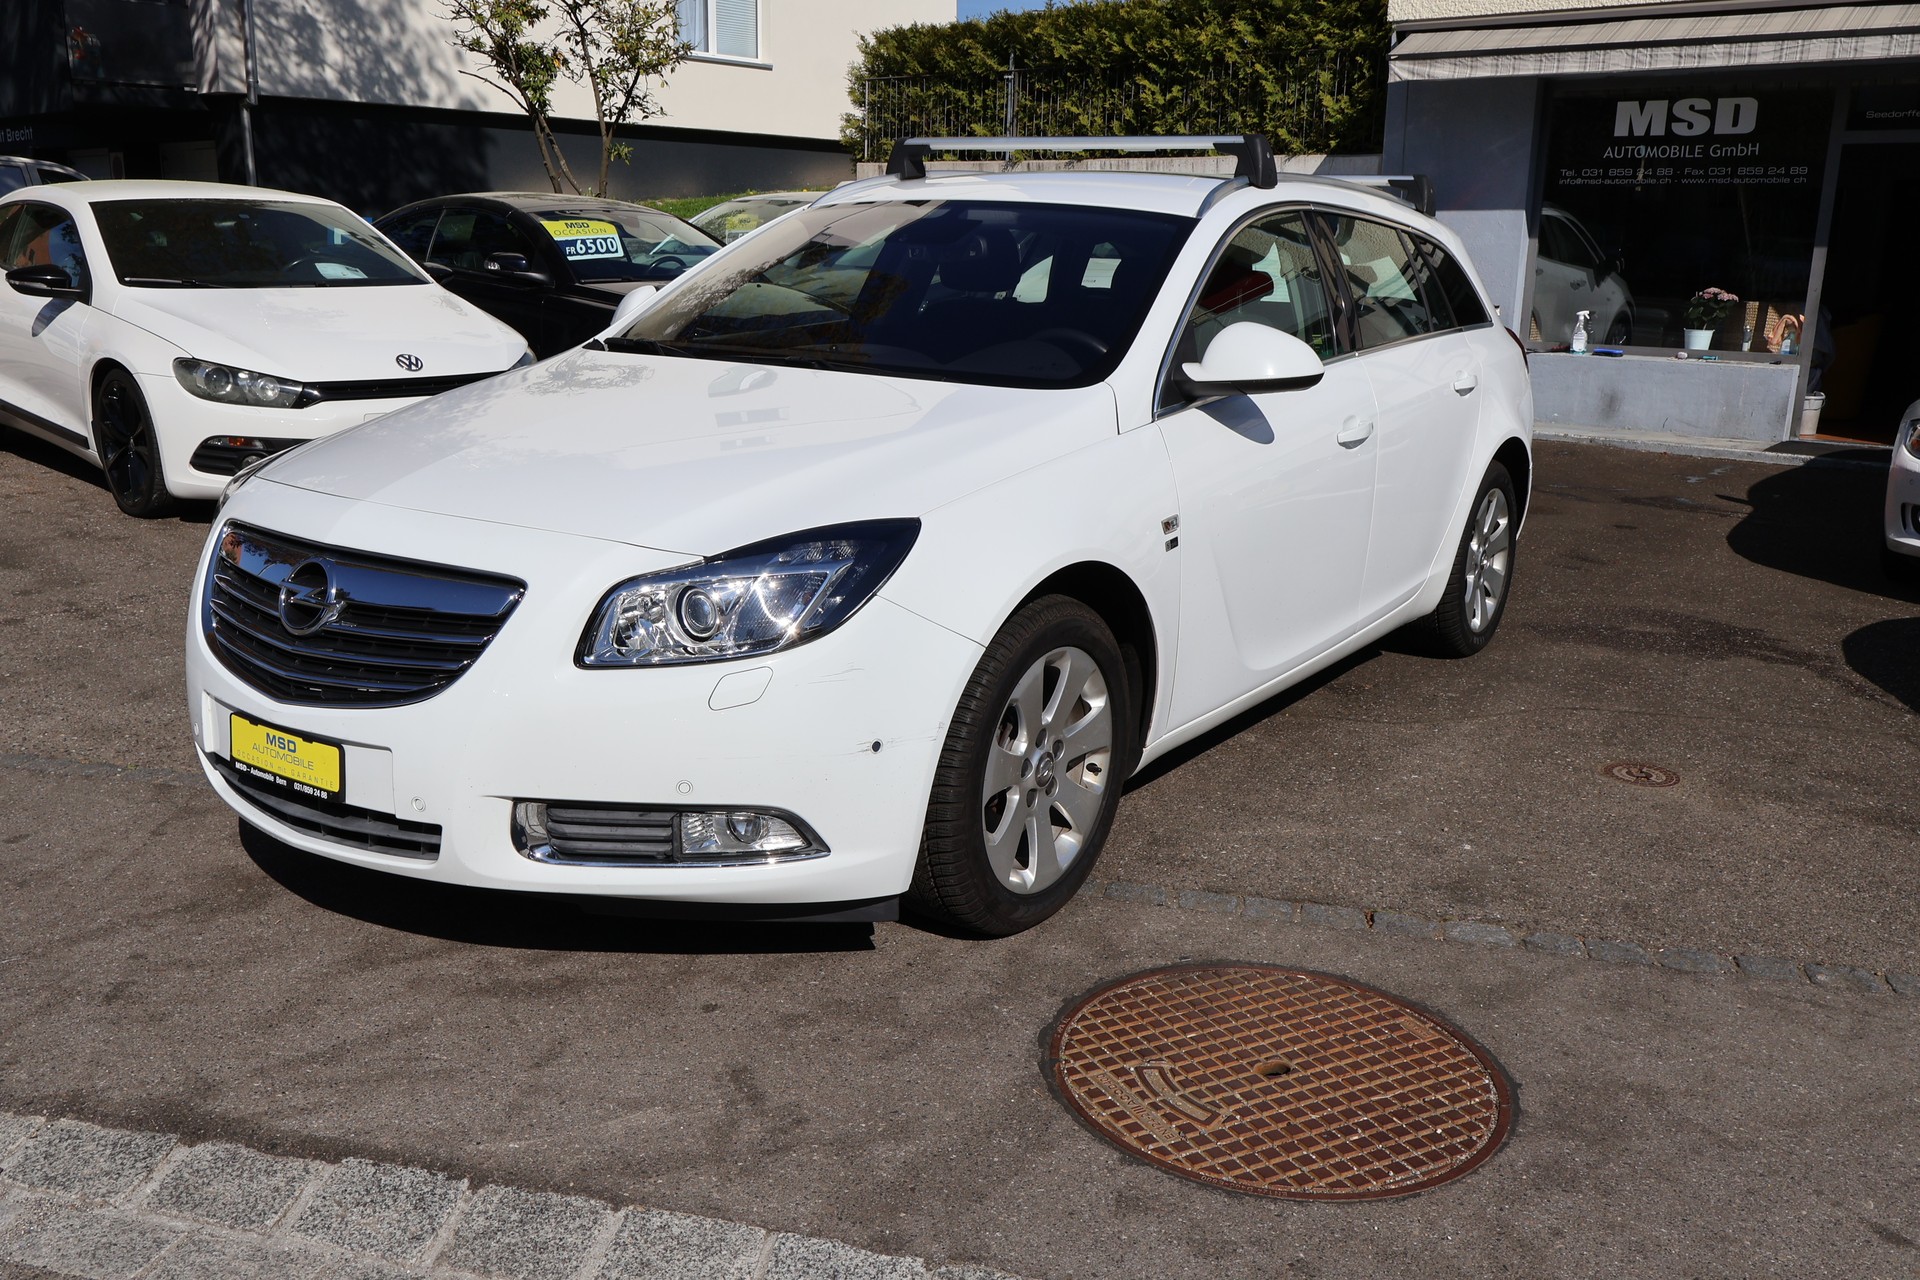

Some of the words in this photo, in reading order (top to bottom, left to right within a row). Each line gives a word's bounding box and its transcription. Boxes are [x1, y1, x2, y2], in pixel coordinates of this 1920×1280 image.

[1613, 97, 1759, 137] MSD
[6, 126, 33, 142] Brecht
[1603, 145, 1704, 159] AUTOMOBILE
[1709, 143, 1760, 158] GmbH
[1560, 169, 1578, 177] Tel.
[1581, 168, 1603, 177] 031
[1608, 168, 1633, 176] 859
[1636, 168, 1653, 176] 24
[1656, 167, 1674, 176] 88
[1684, 167, 1705, 176] Fax
[1708, 167, 1732, 176] 031
[1737, 166, 1764, 175] 859
[1767, 166, 1786, 175] 24
[1789, 166, 1808, 175] 89
[553, 228, 607, 236] OCCASION
[576, 238, 617, 254] 6500
[266, 732, 297, 753] MSD
[252, 742, 314, 771] AUTOMOBILE
[237, 749, 274, 768] OCCASION
[290, 769, 334, 789] GARANTIE
[250, 767, 275, 782] Automobile
[275, 775, 288, 787] Bern
